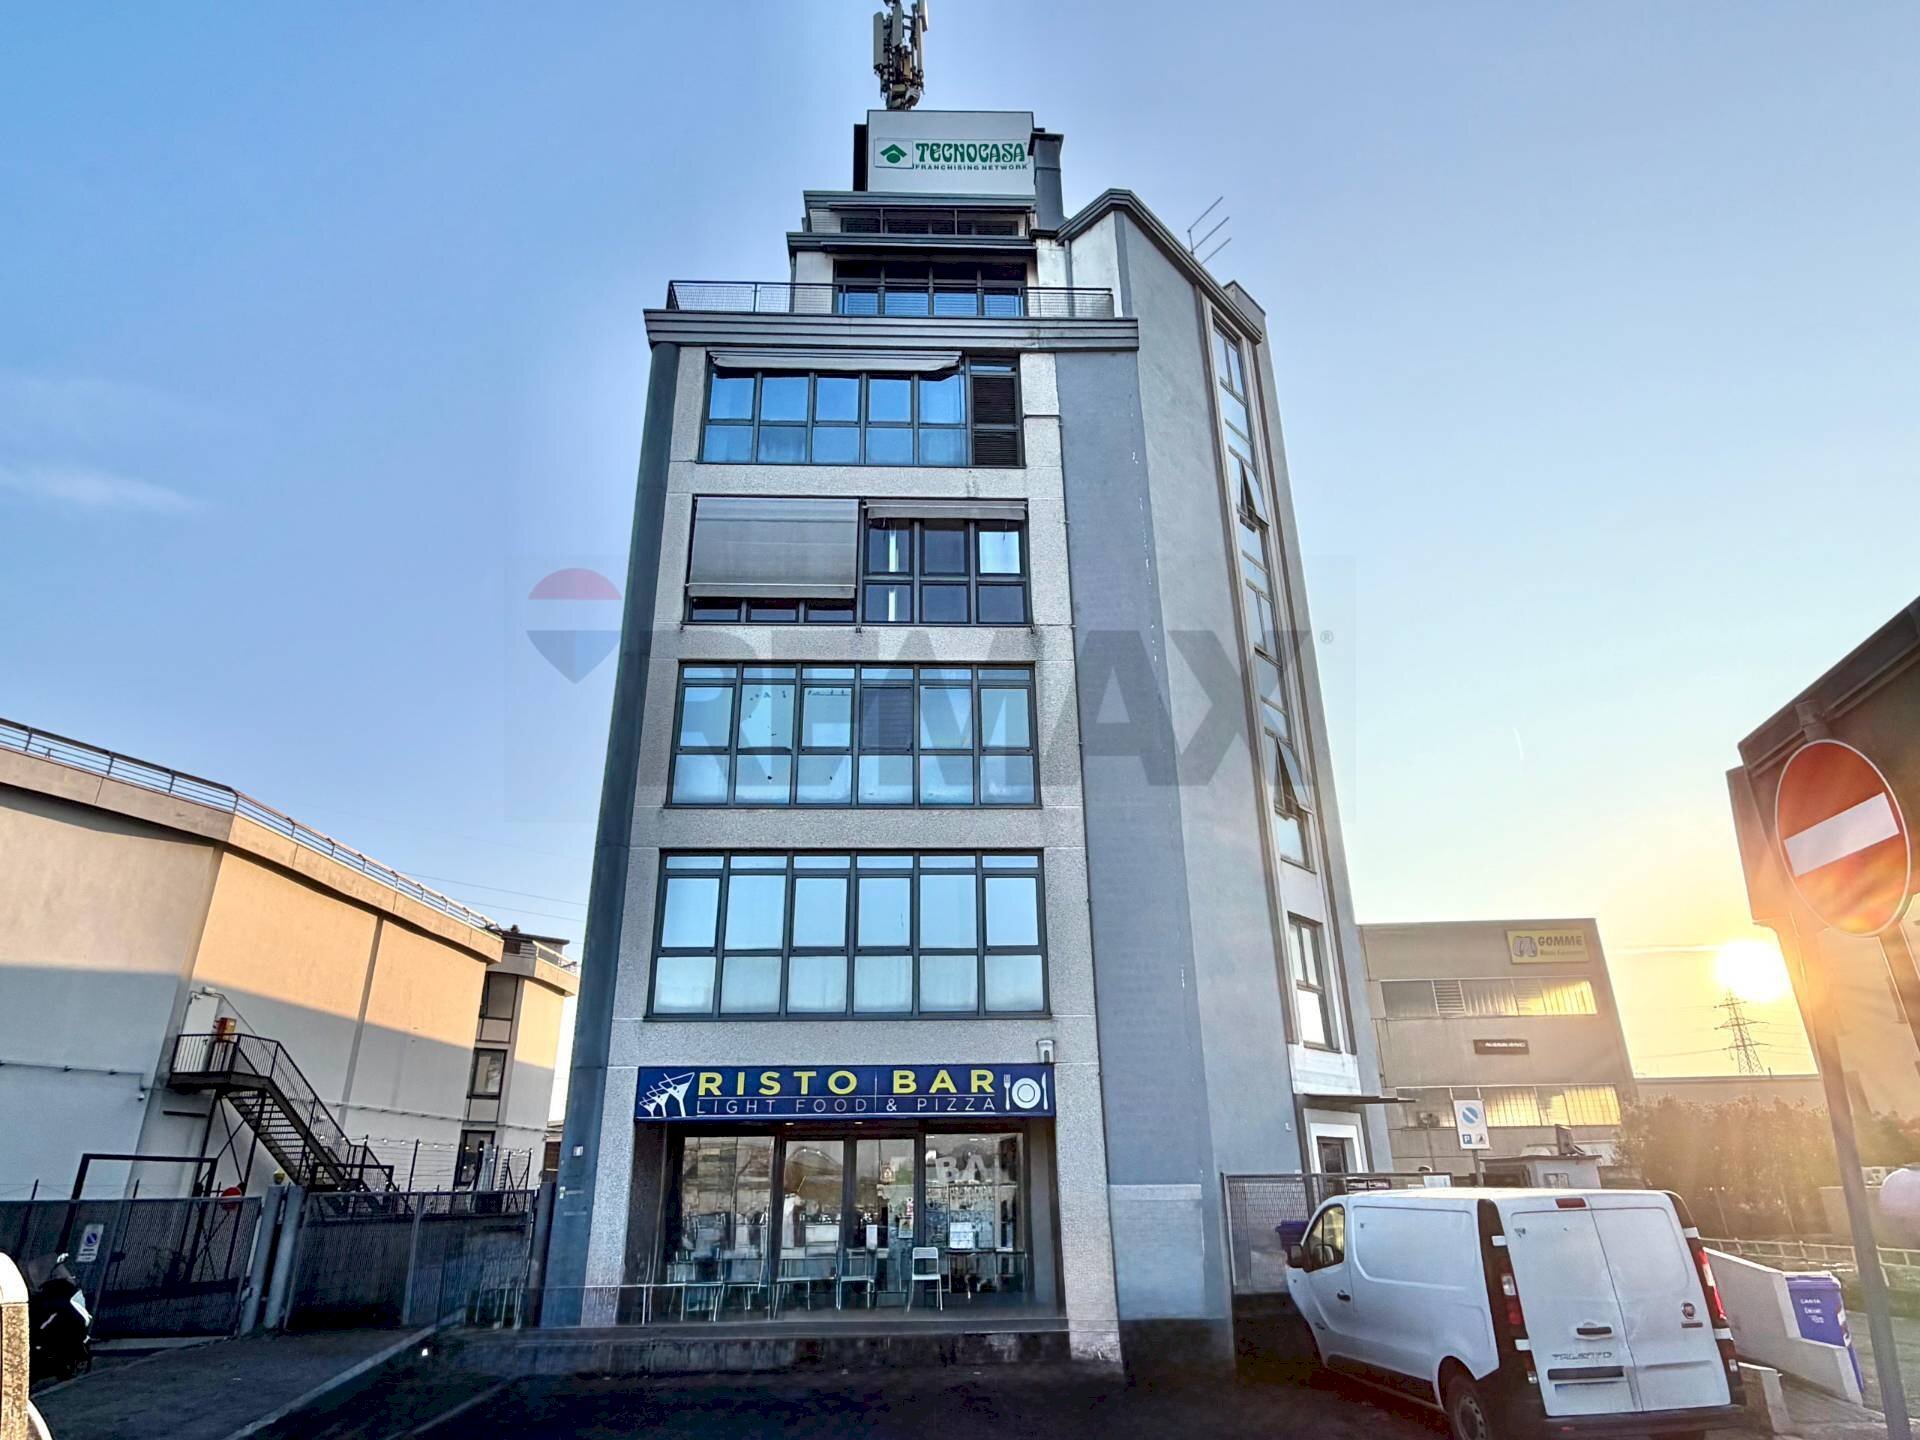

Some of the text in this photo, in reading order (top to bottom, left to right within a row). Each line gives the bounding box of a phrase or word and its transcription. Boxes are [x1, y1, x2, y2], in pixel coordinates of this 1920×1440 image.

[915, 143, 1025, 163] TECNOCASA
[1538, 936, 1583, 946] GOMME
[698, 1070, 995, 1095] RISTO BAR
[697, 1098, 995, 1114] LIGHT FOOD & PIZZA
